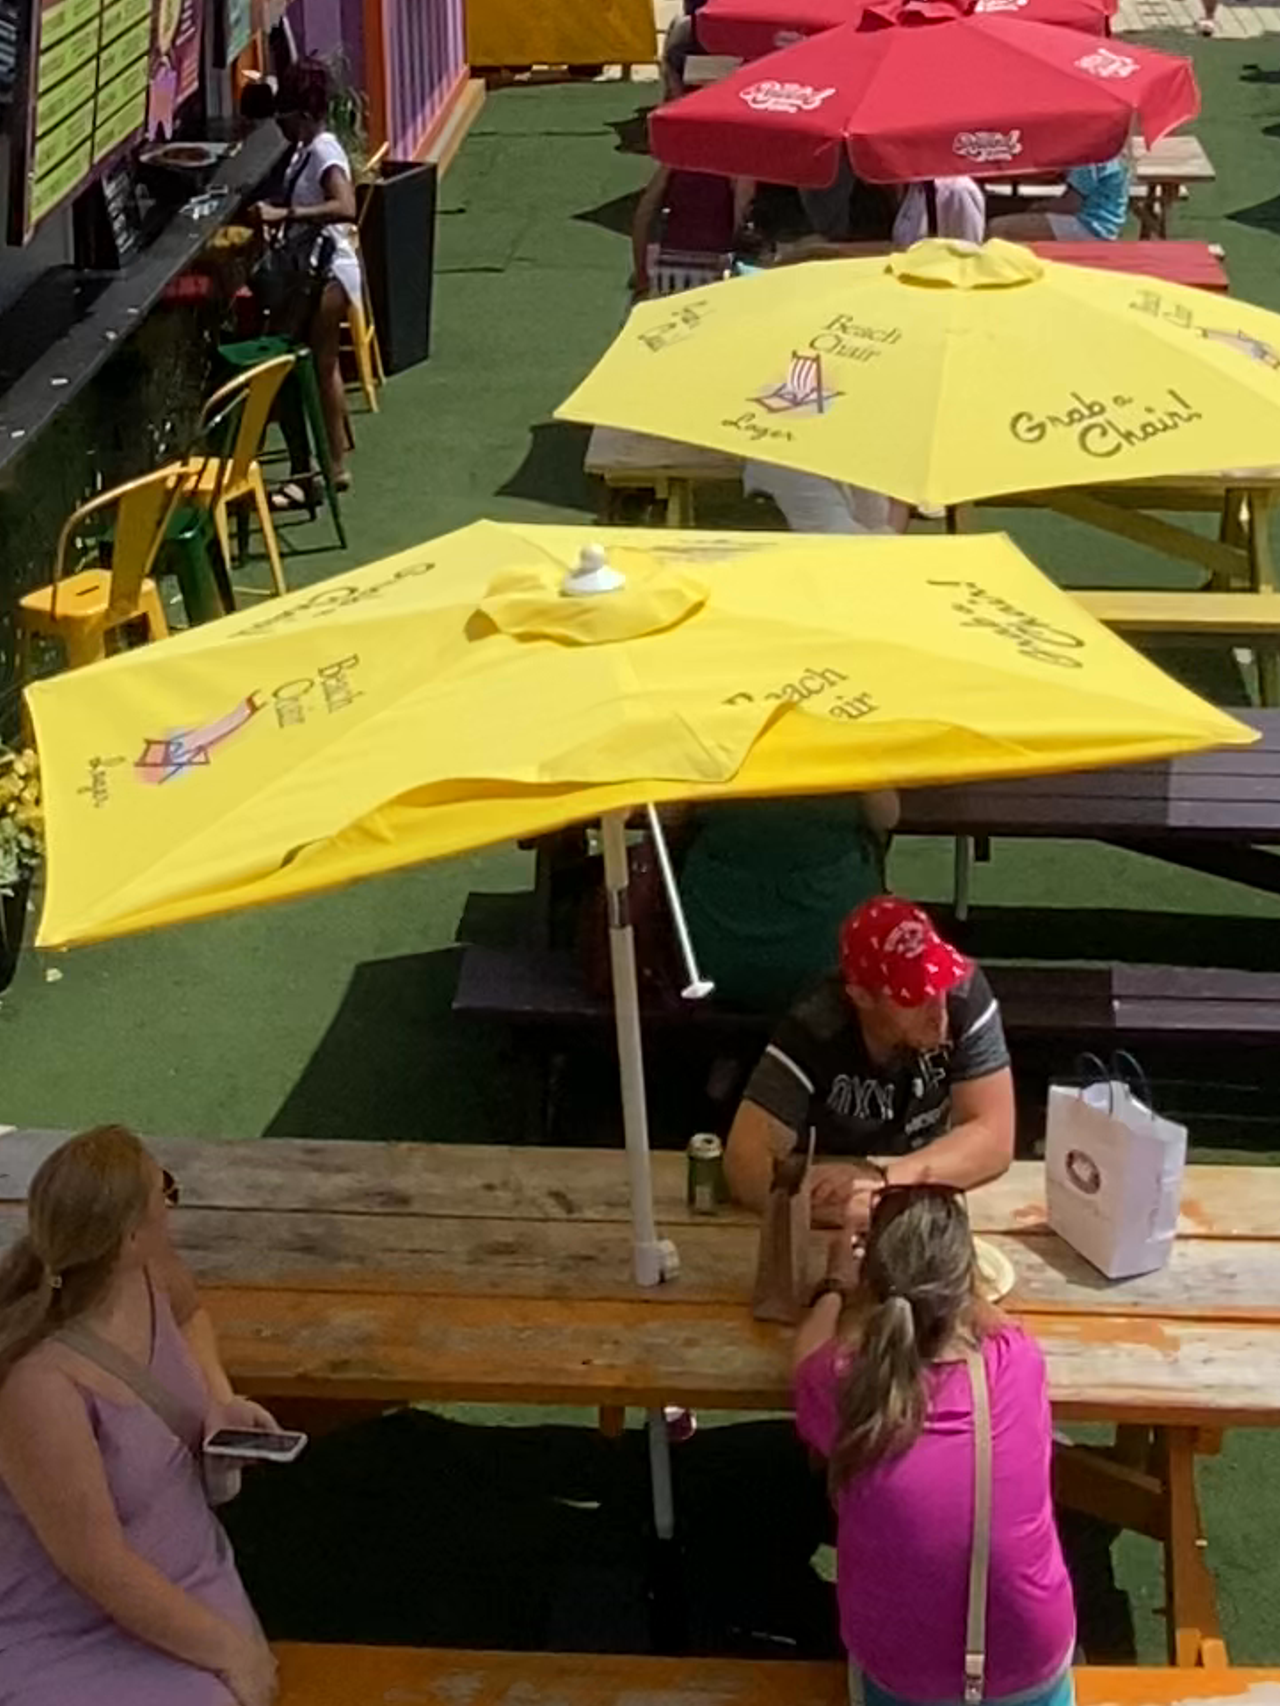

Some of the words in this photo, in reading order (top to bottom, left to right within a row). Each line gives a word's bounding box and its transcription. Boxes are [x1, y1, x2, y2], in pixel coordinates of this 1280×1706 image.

[825, 314, 901, 344] Beach
[809, 333, 881, 363] Chair
[721, 413, 797, 441] Lager
[1010, 392, 1107, 443] Grab
[1113, 395, 1133, 407] a
[1078, 389, 1202, 458] Chair!
